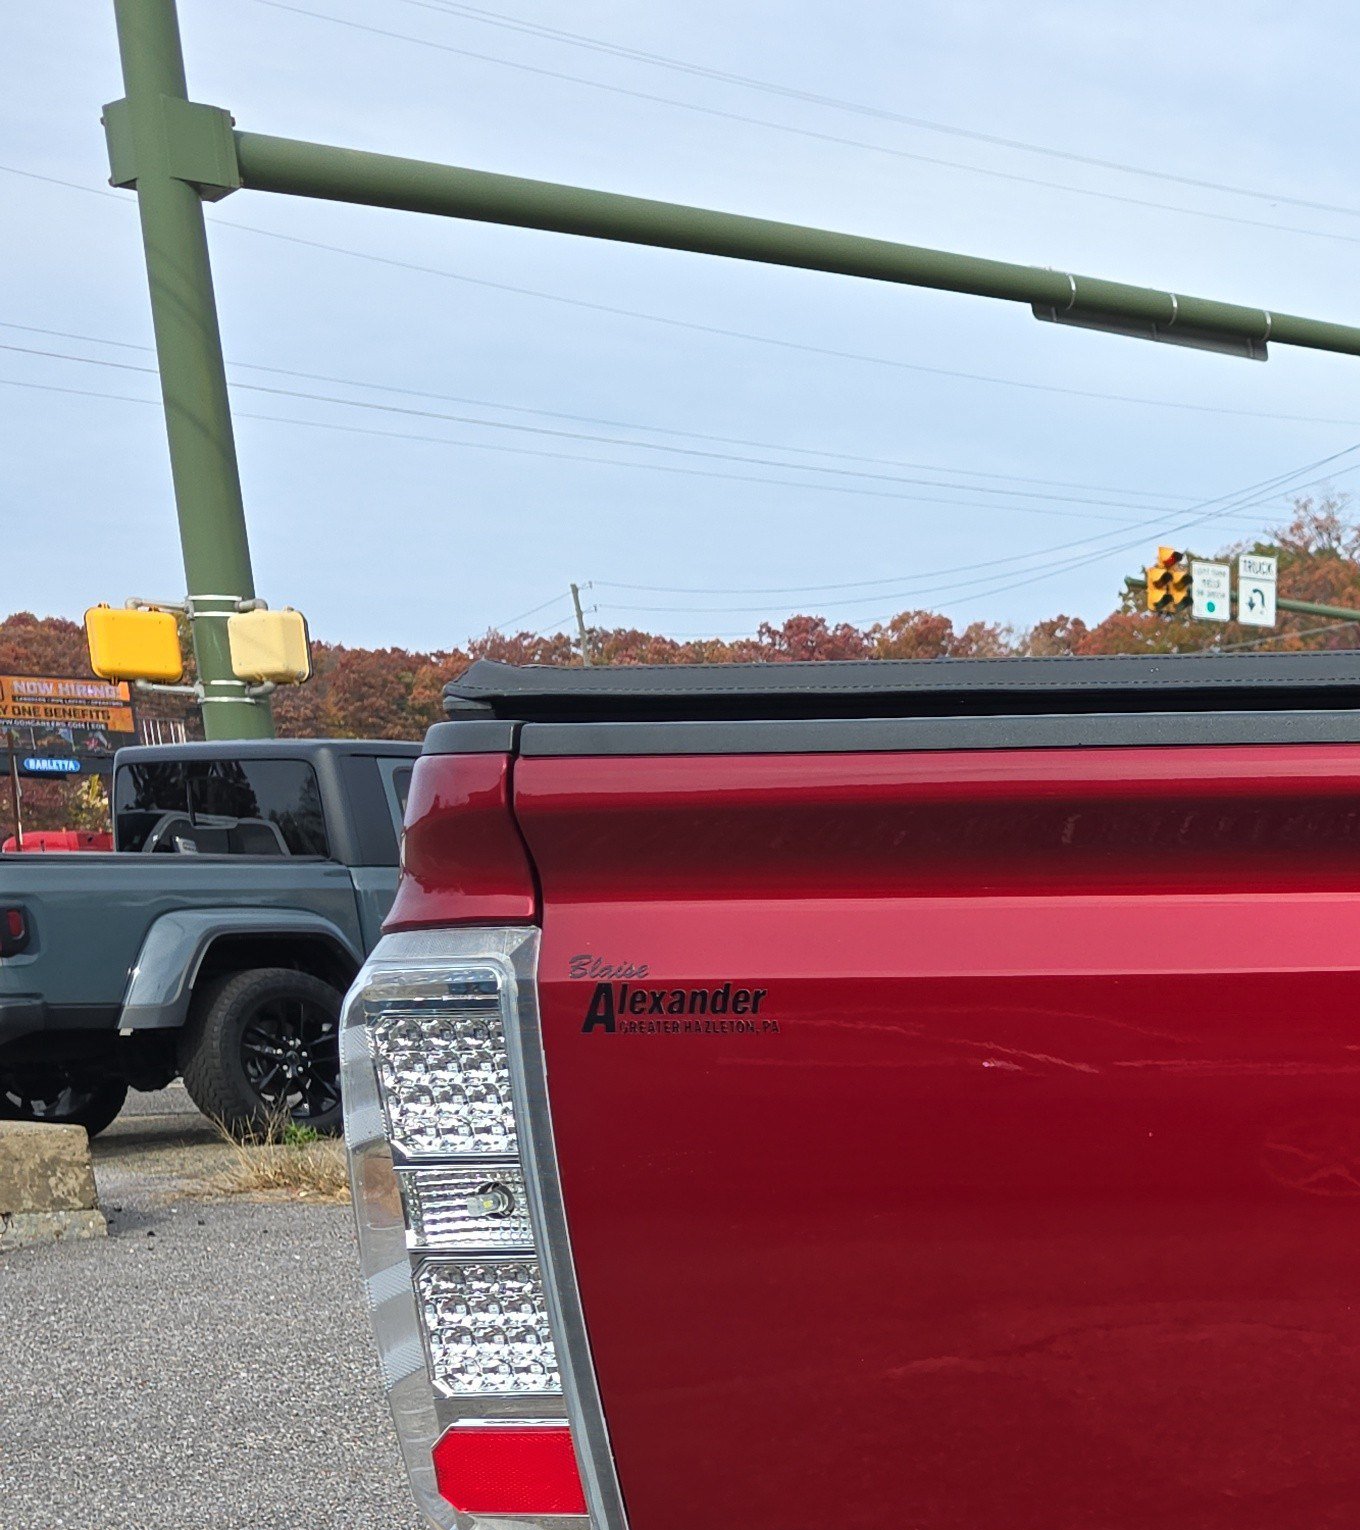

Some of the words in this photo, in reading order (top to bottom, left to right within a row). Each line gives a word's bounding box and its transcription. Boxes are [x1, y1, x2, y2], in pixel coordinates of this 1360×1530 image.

[1243, 560, 1273, 575] TRUCK
[13, 680, 54, 695] NOW
[12, 705, 40, 717] ONE
[45, 706, 110, 720] BENEFITS
[29, 758, 75, 770] BARLETTA
[568, 954, 650, 980] Blaise
[581, 982, 768, 1034] Alexander
[619, 1020, 680, 1034] GREATER
[763, 1019, 780, 1034] PA
